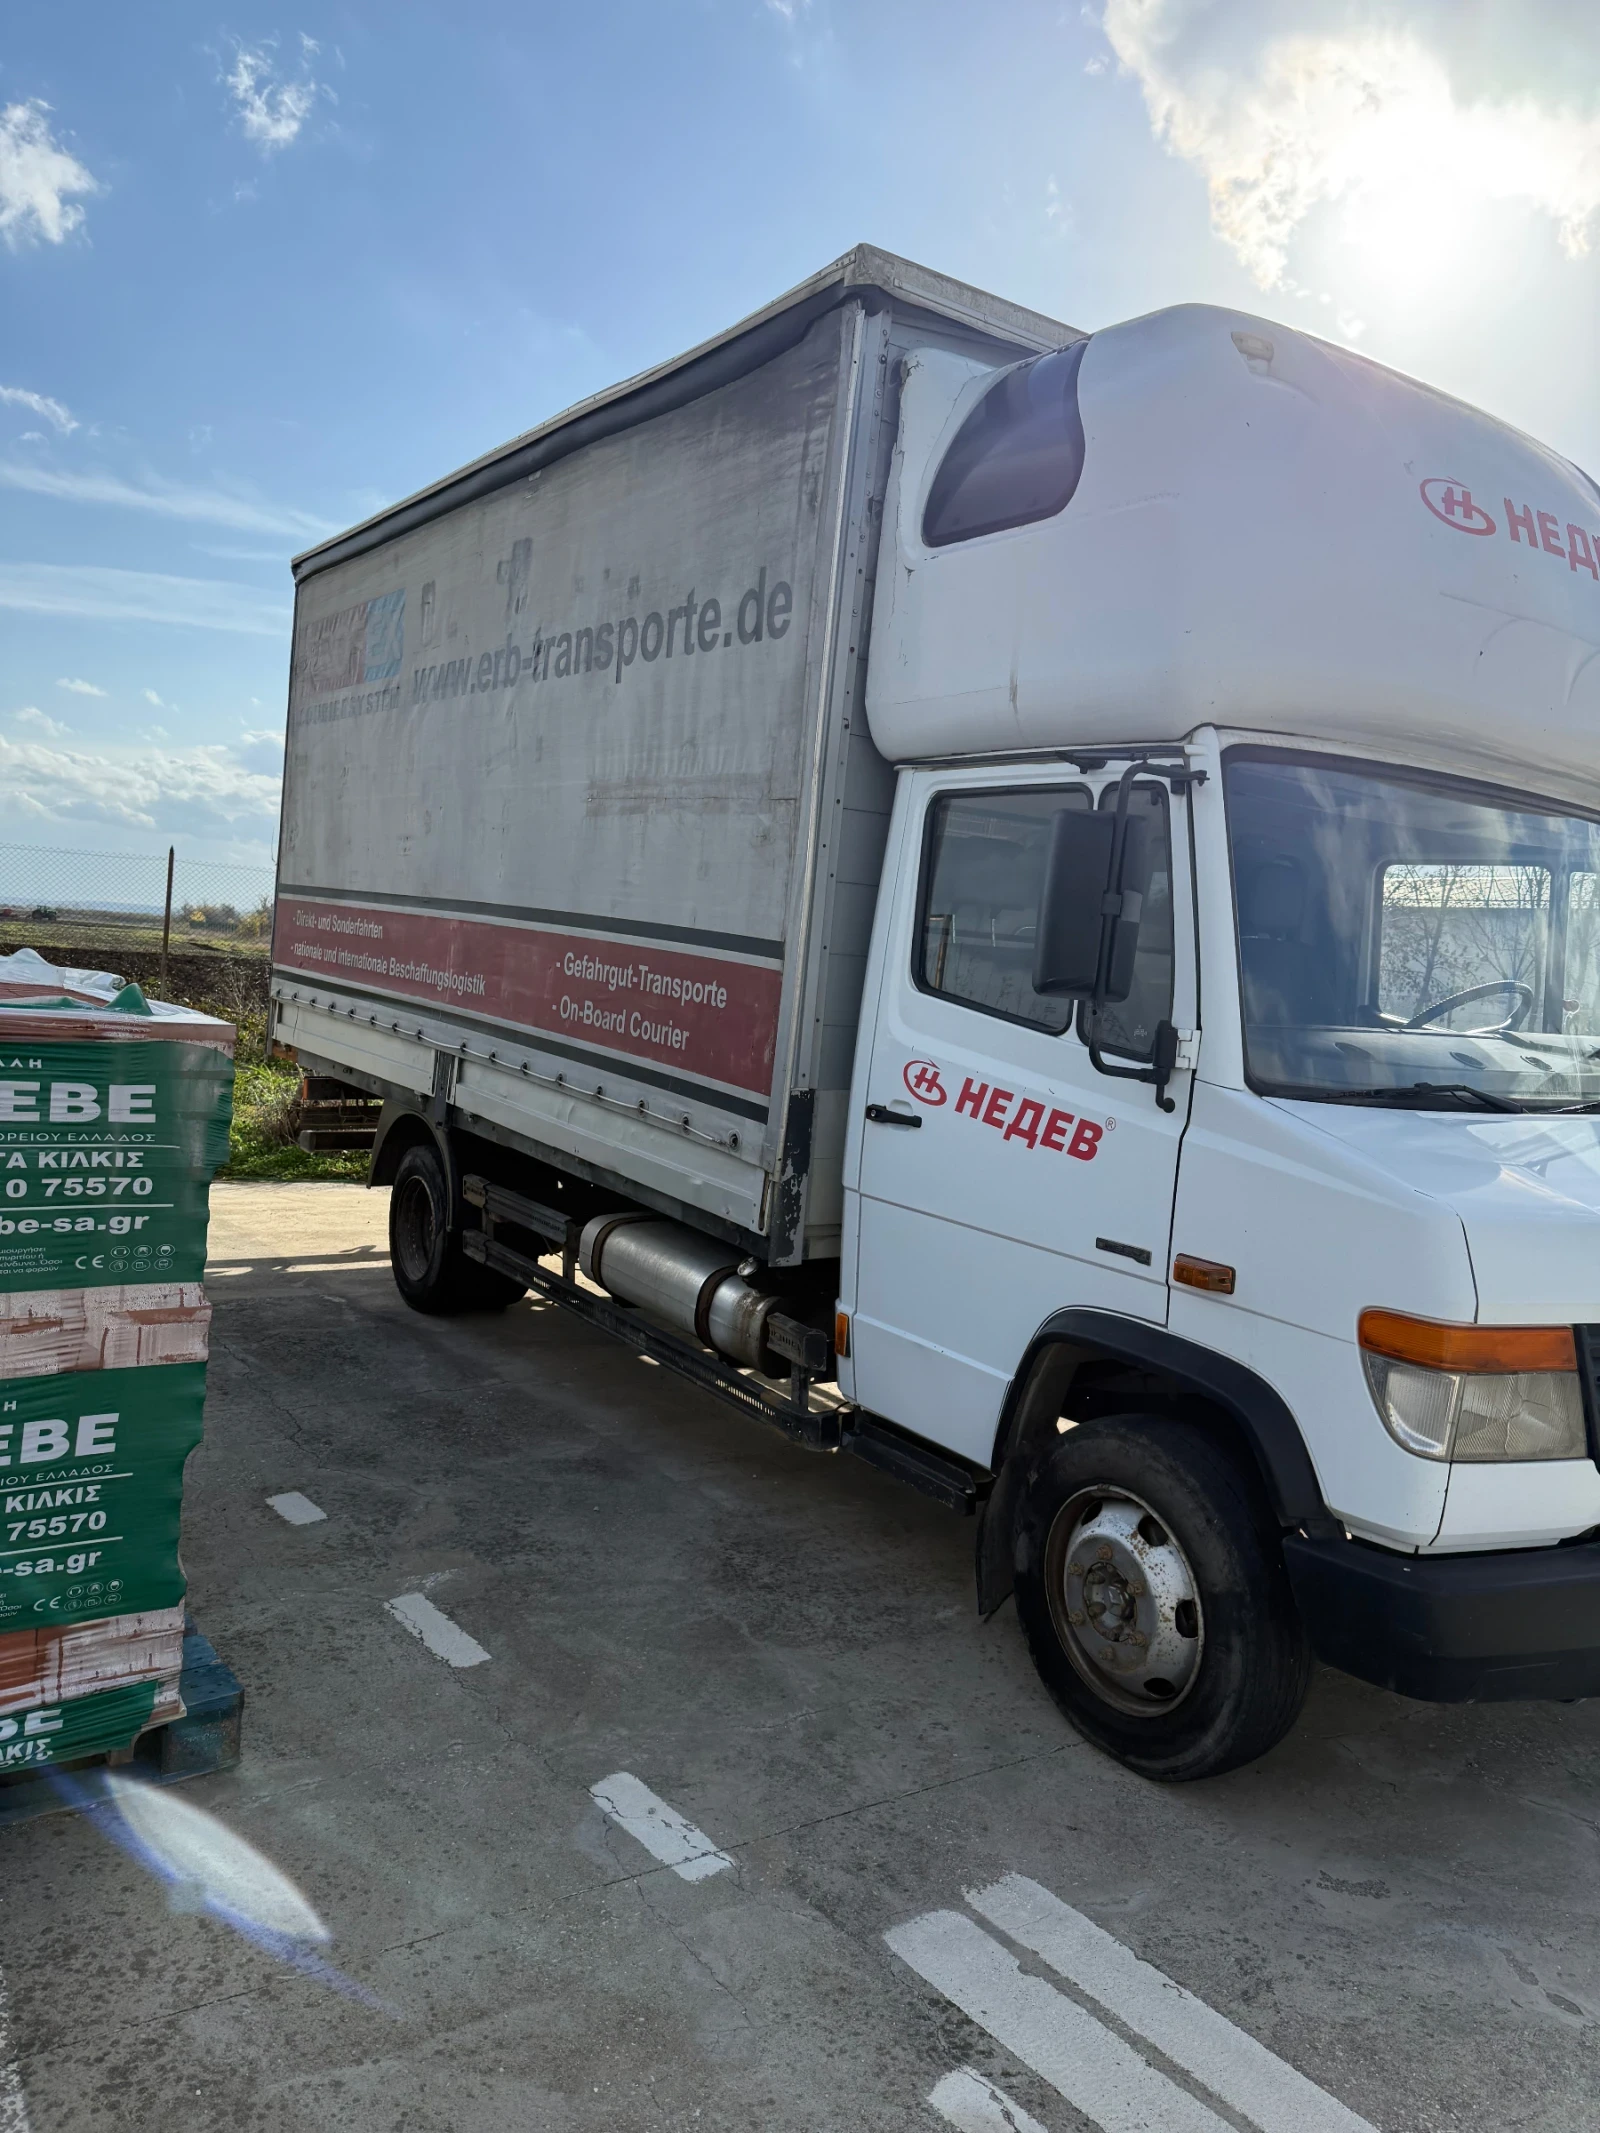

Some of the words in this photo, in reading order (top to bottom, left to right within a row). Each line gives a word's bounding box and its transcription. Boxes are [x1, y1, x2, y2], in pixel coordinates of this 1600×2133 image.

[1504, 497, 1600, 581] НЕД
[413, 566, 794, 704] www.erb-transporte.de
[296, 909, 317, 928] Direkt-
[318, 914, 332, 931] und
[332, 914, 383, 939] Sonderfahrten
[294, 941, 322, 960] nationale
[324, 945, 336, 963] und
[389, 957, 486, 996] Beschaffungslogistik
[564, 952, 727, 1008] Gefahrgut-Transporte
[560, 995, 626, 1034] On-Board
[630, 1012, 690, 1050] Courier
[0, 1133, 61, 1142] ΡΕΙΟΥ
[68, 1133, 156, 1142] ΕΛΛΑΔΟΣ
[38, 1151, 144, 1168] ΚΙΛΚΙΣ
[41, 1177, 153, 1197] 75570
[36, 1463, 114, 1482] ΕΛΛΑΔΟΣ
[5, 1484, 102, 1514] ΚΙΛΚΙΣ
[7, 1510, 107, 1541] 75570
[0, 1551, 102, 1577] -sa.gr
[0, 1738, 51, 1760] ΚΙΣ
